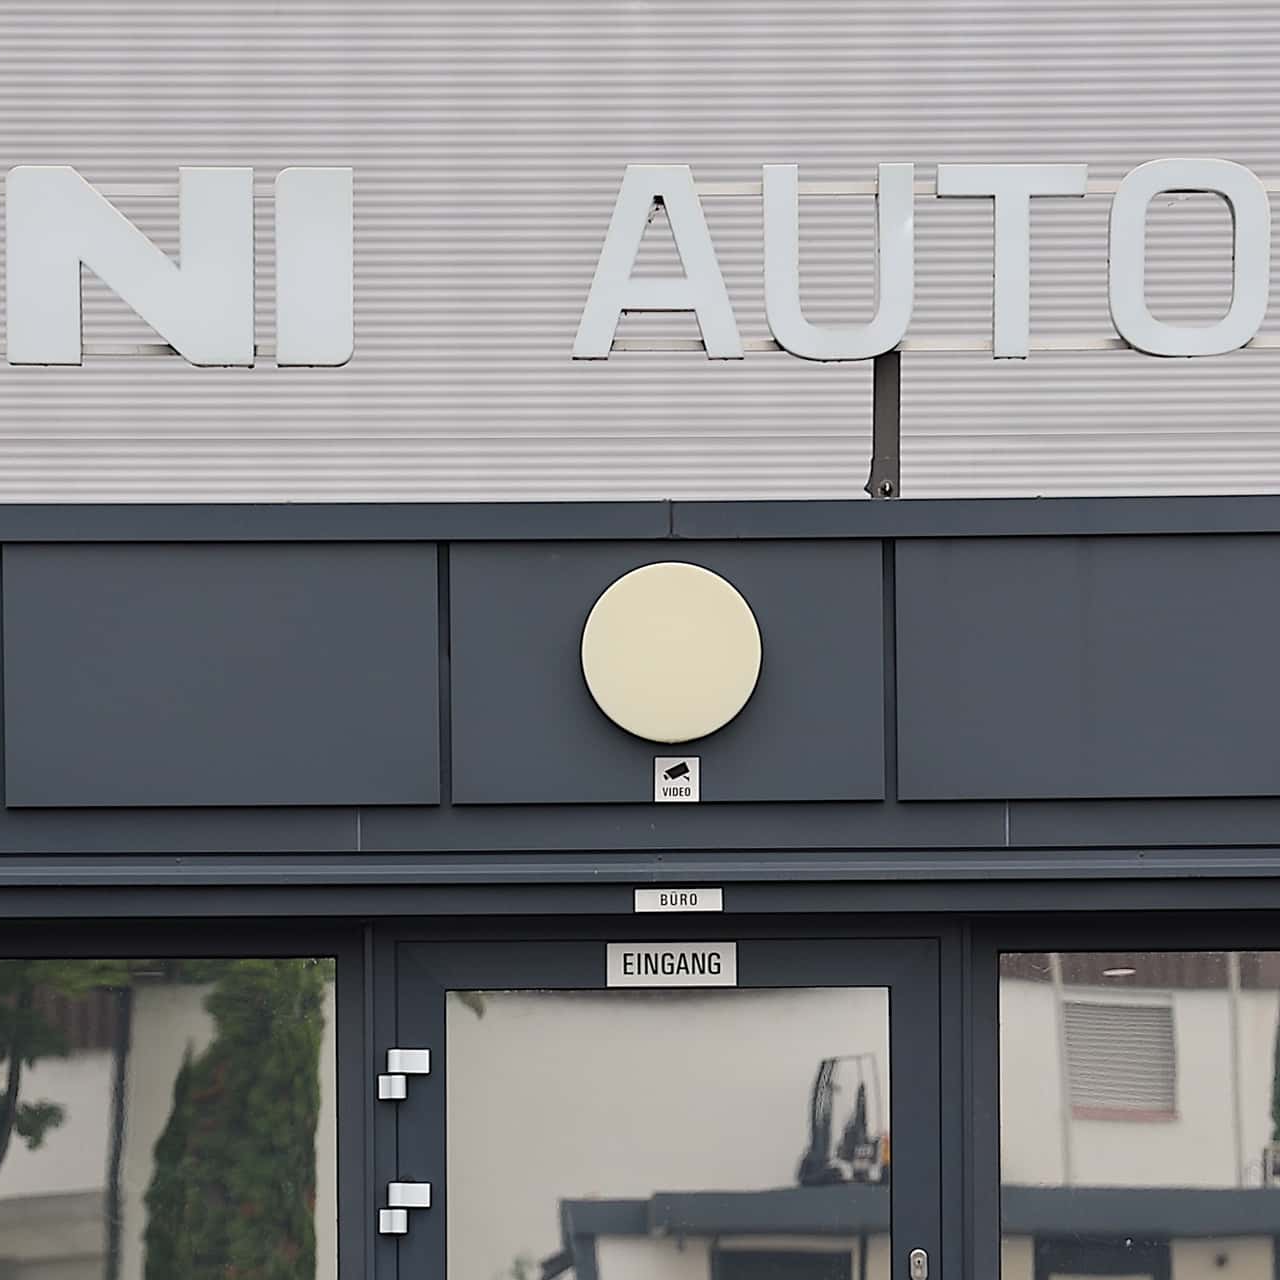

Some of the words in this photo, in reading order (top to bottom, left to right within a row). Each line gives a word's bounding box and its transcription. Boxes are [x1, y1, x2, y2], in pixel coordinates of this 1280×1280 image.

[572, 157, 1272, 362] AUTO
[662, 786, 692, 798] VIDEO
[660, 892, 699, 906] BÜRO
[623, 952, 722, 975] EINGANG
